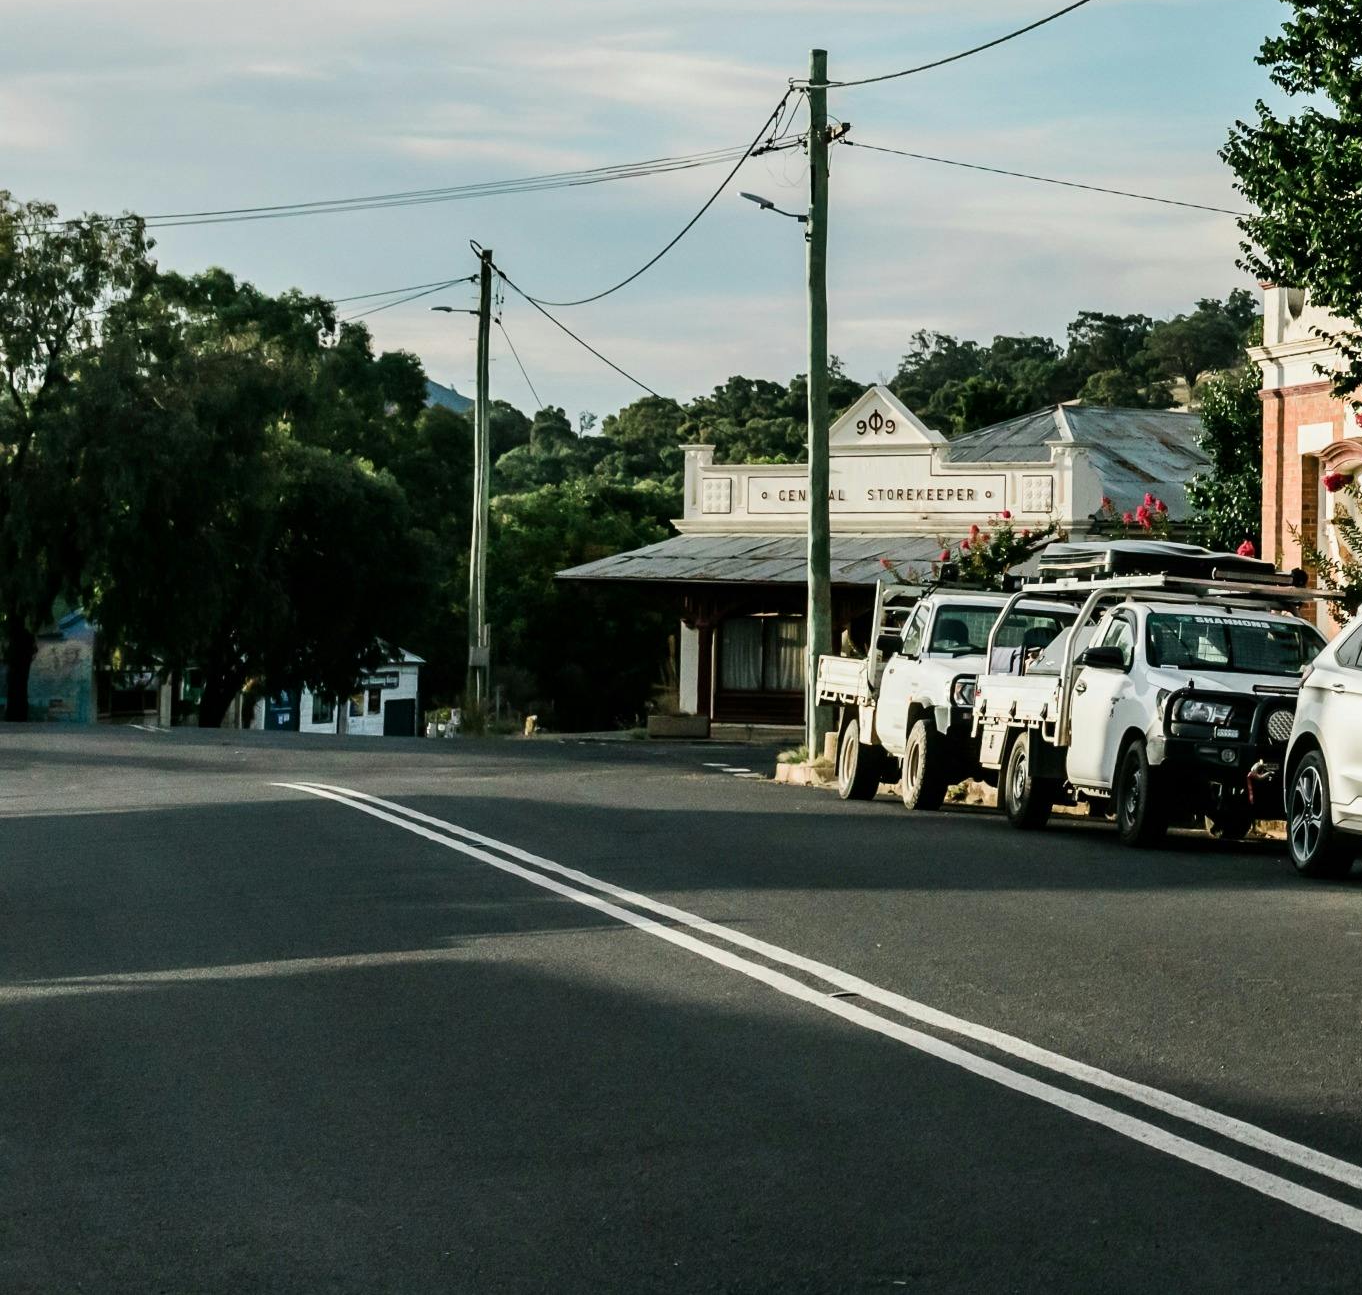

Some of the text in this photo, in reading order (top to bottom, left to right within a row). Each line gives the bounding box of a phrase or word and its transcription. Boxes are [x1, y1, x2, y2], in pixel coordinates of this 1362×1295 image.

[778, 488, 975, 502] GENAL STOREKEEPER
[1195, 615, 1271, 630] SHANNONS
